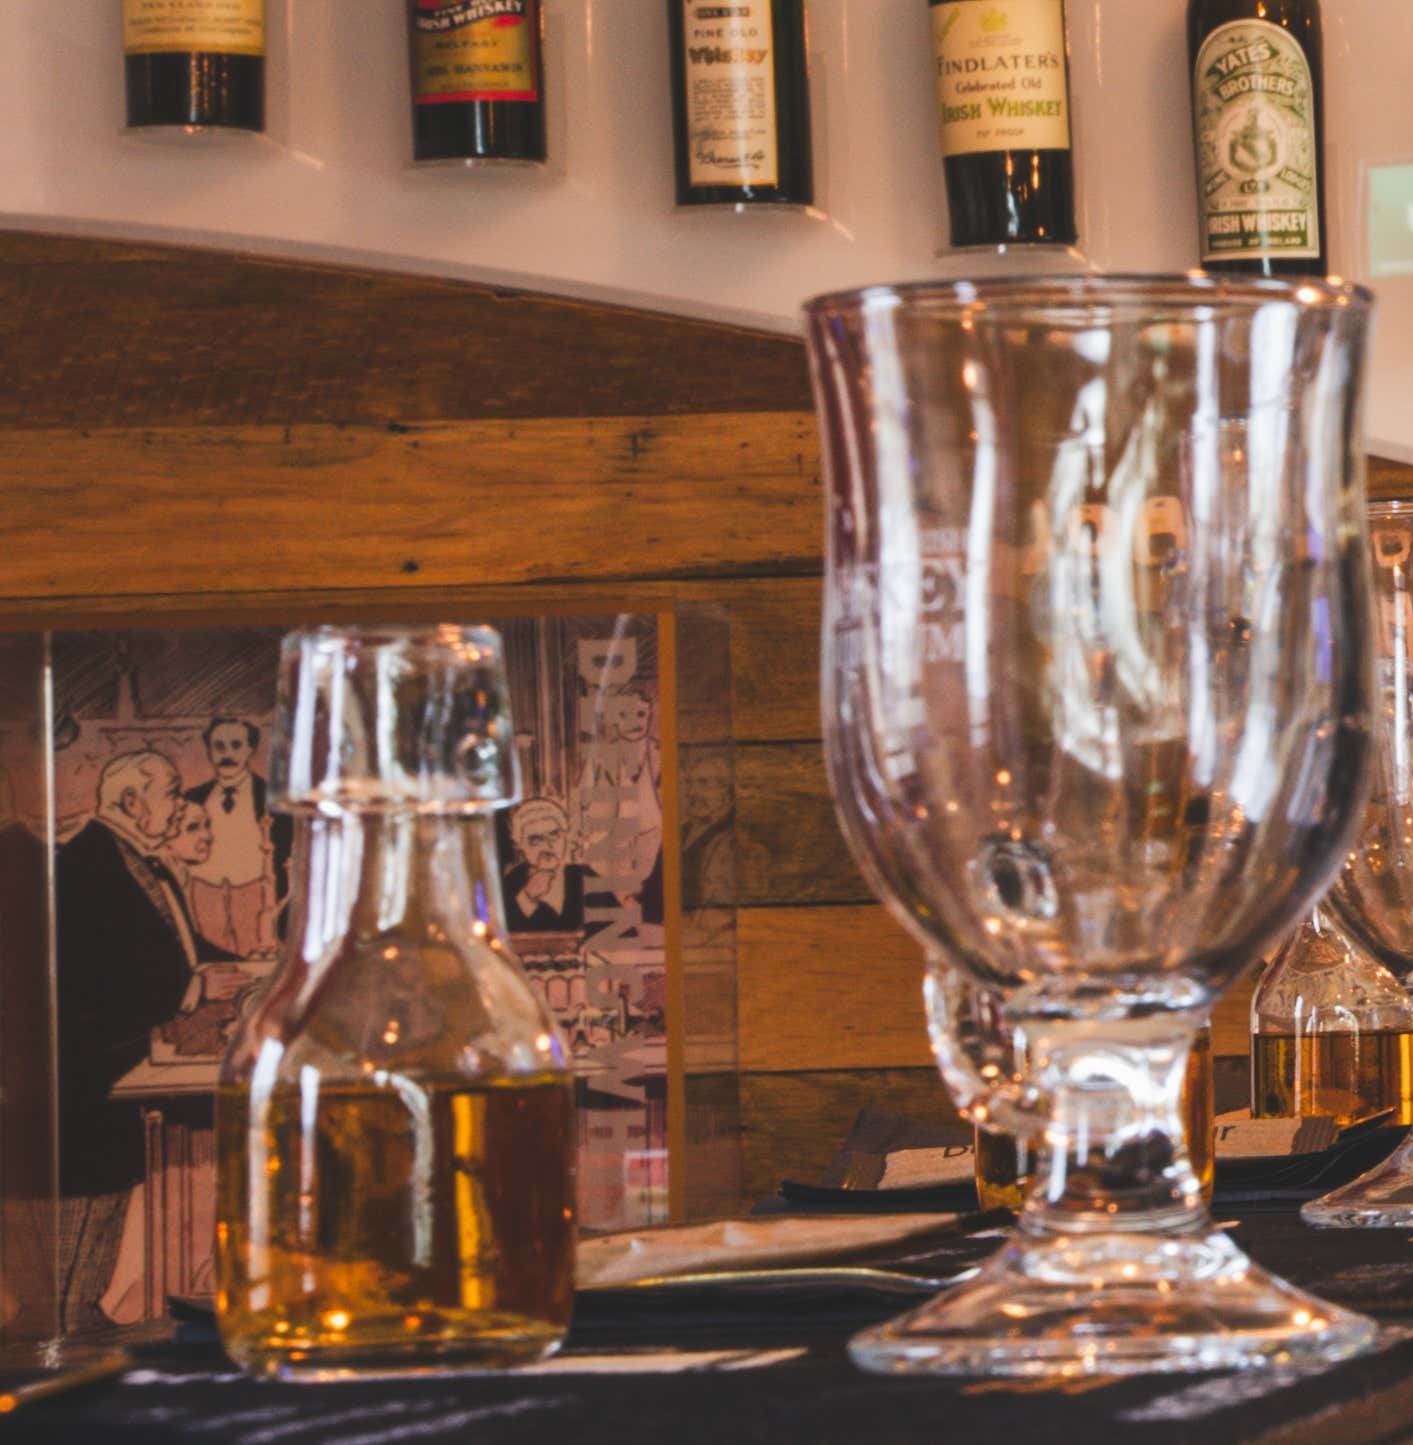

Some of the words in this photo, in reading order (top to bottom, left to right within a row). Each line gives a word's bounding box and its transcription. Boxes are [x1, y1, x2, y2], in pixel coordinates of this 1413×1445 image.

[1215, 42, 1272, 75] YATES
[956, 77, 1015, 94] Celebrated
[1022, 77, 1042, 89] Old
[1219, 74, 1295, 100] BROTHERS
[1241, 212, 1307, 233] WHISKEY
